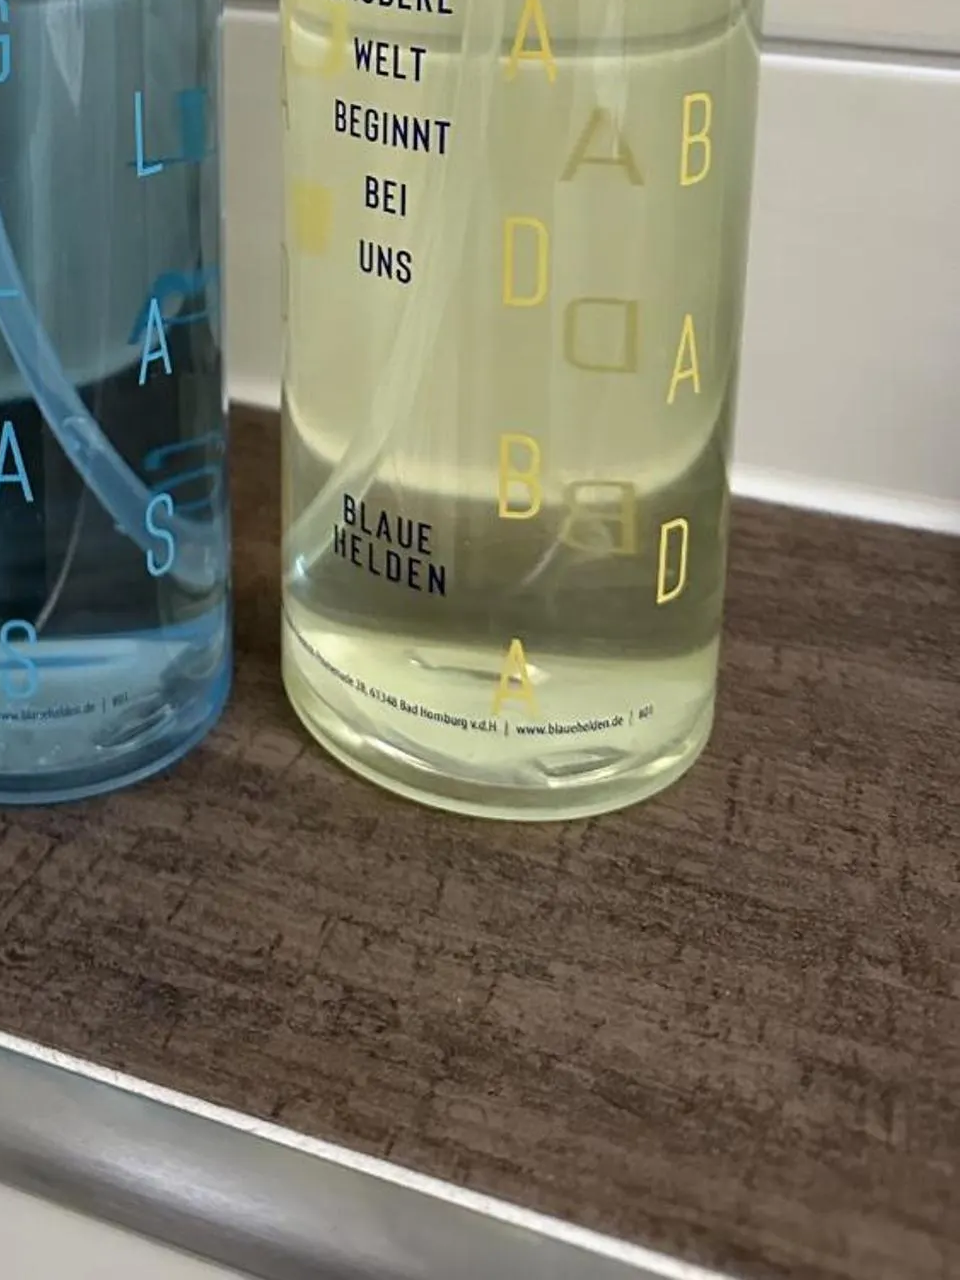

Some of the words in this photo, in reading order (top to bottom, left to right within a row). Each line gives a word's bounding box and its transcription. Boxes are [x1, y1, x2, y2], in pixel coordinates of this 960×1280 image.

[354, 37, 426, 82] WELT
[335, 98, 450, 154] BEGINNT
[365, 175, 406, 216] BEI
[359, 239, 412, 284] UNS
[344, 493, 432, 555] BLAUE
[334, 524, 446, 598] HELDEN
[400, 699, 418, 715] Bad
[420, 706, 468, 730] Homburg
